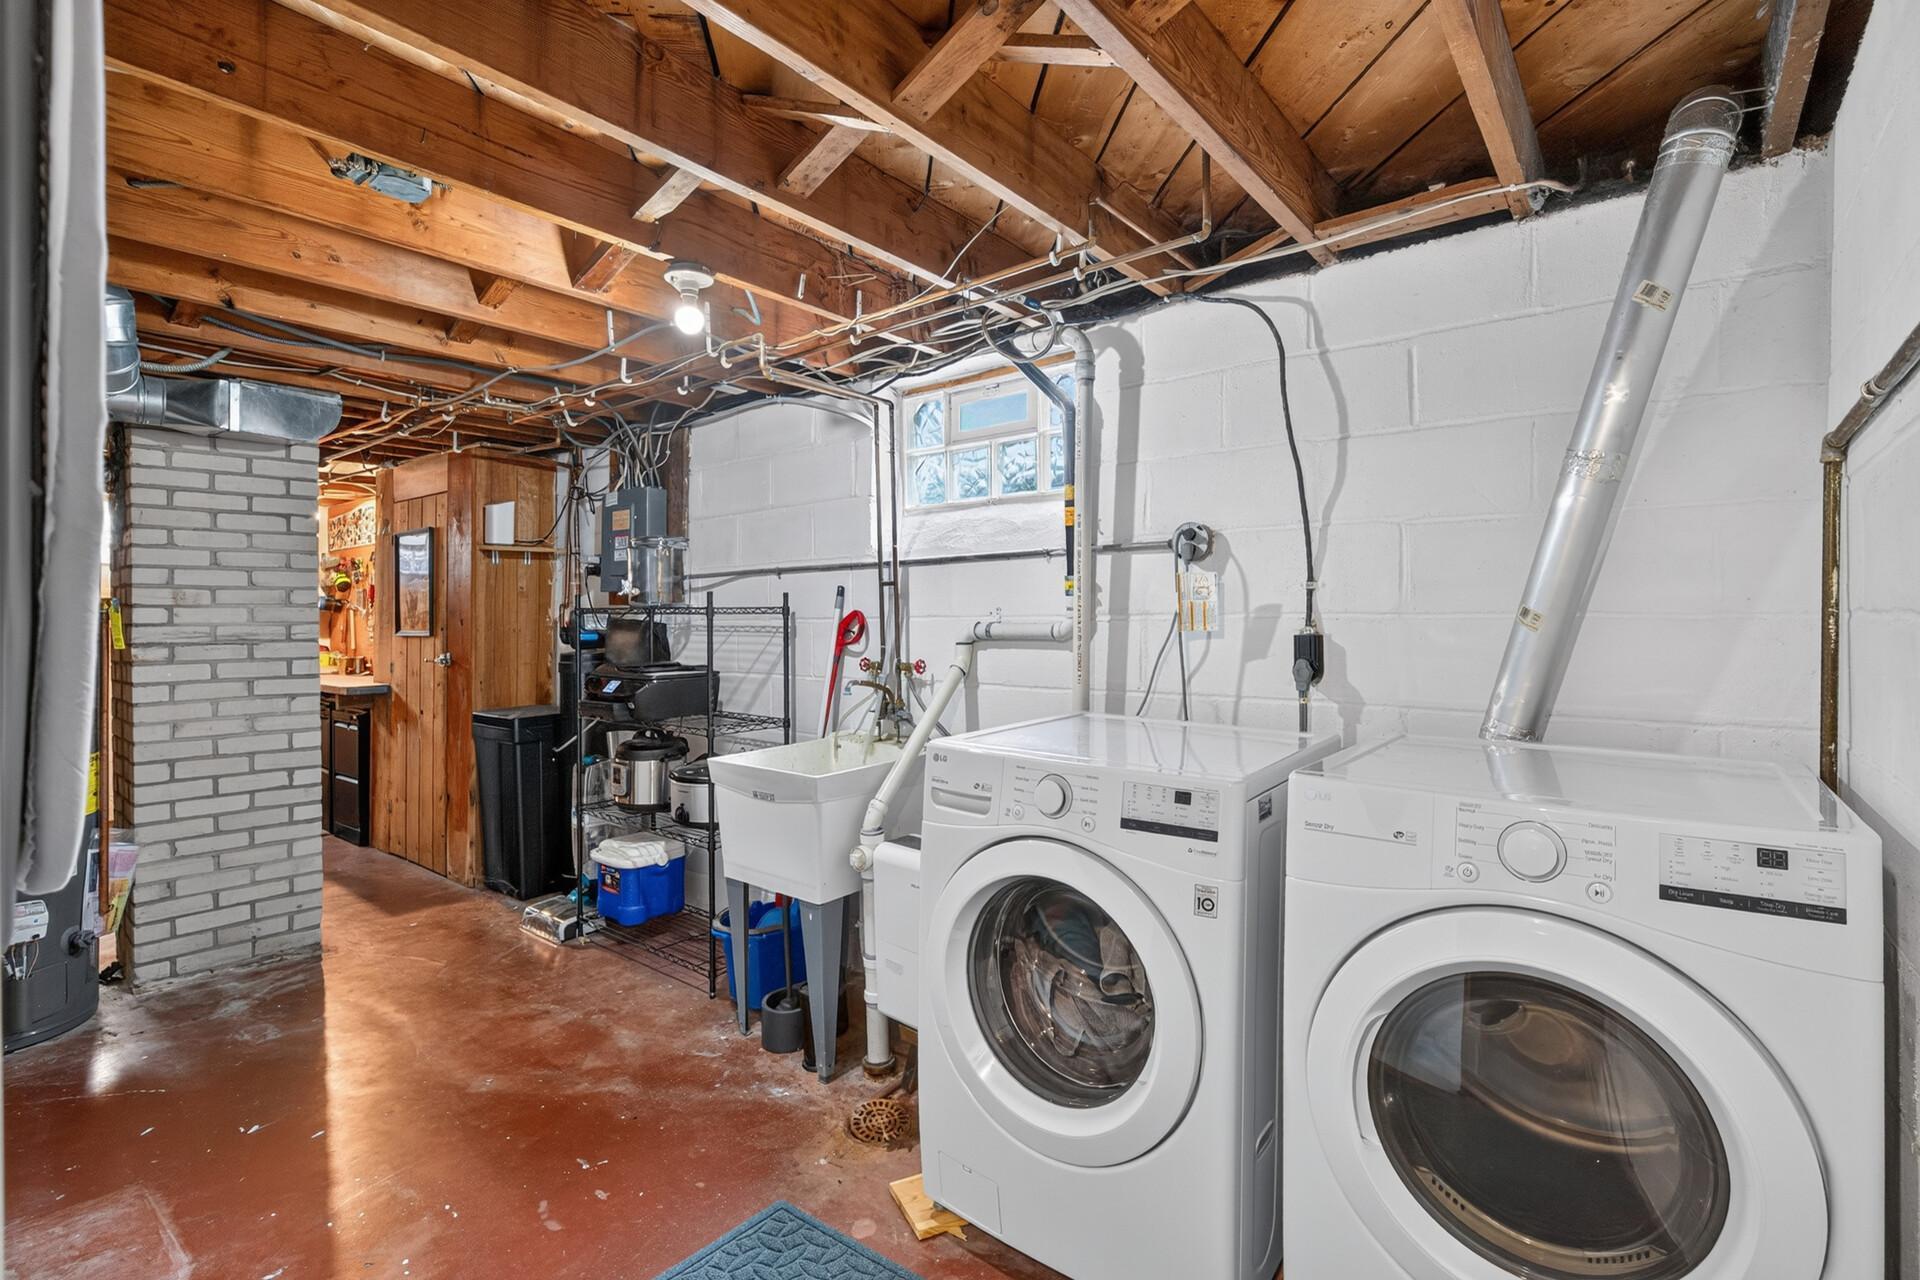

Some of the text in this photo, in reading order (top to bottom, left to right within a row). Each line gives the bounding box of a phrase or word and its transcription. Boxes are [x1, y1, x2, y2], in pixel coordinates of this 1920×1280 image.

[1304, 820, 1335, 832] Sensor Dry
[1602, 874, 1614, 883] Dry
